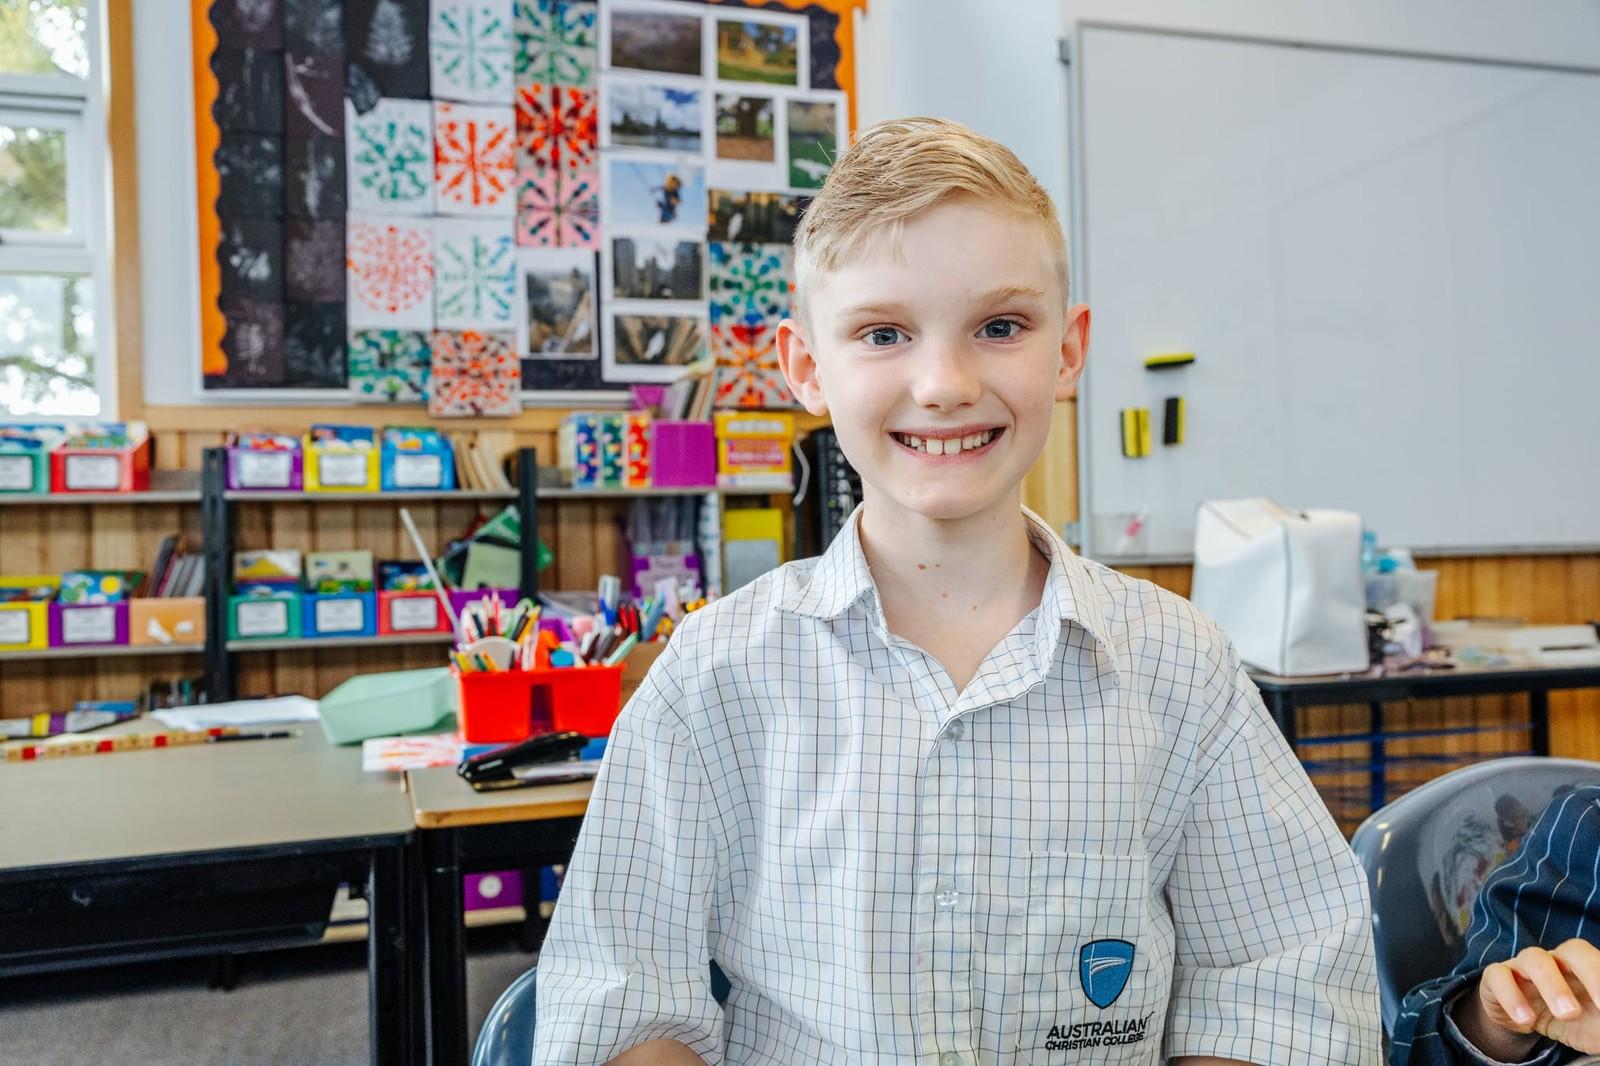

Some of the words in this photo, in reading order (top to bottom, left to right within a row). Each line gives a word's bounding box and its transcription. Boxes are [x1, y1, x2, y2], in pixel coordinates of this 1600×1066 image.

[1047, 1018, 1147, 1039] AUSTRALIAN
[1045, 1037, 1102, 1051] CHRISTIAN
[1103, 1031, 1145, 1046] COLLEGE
